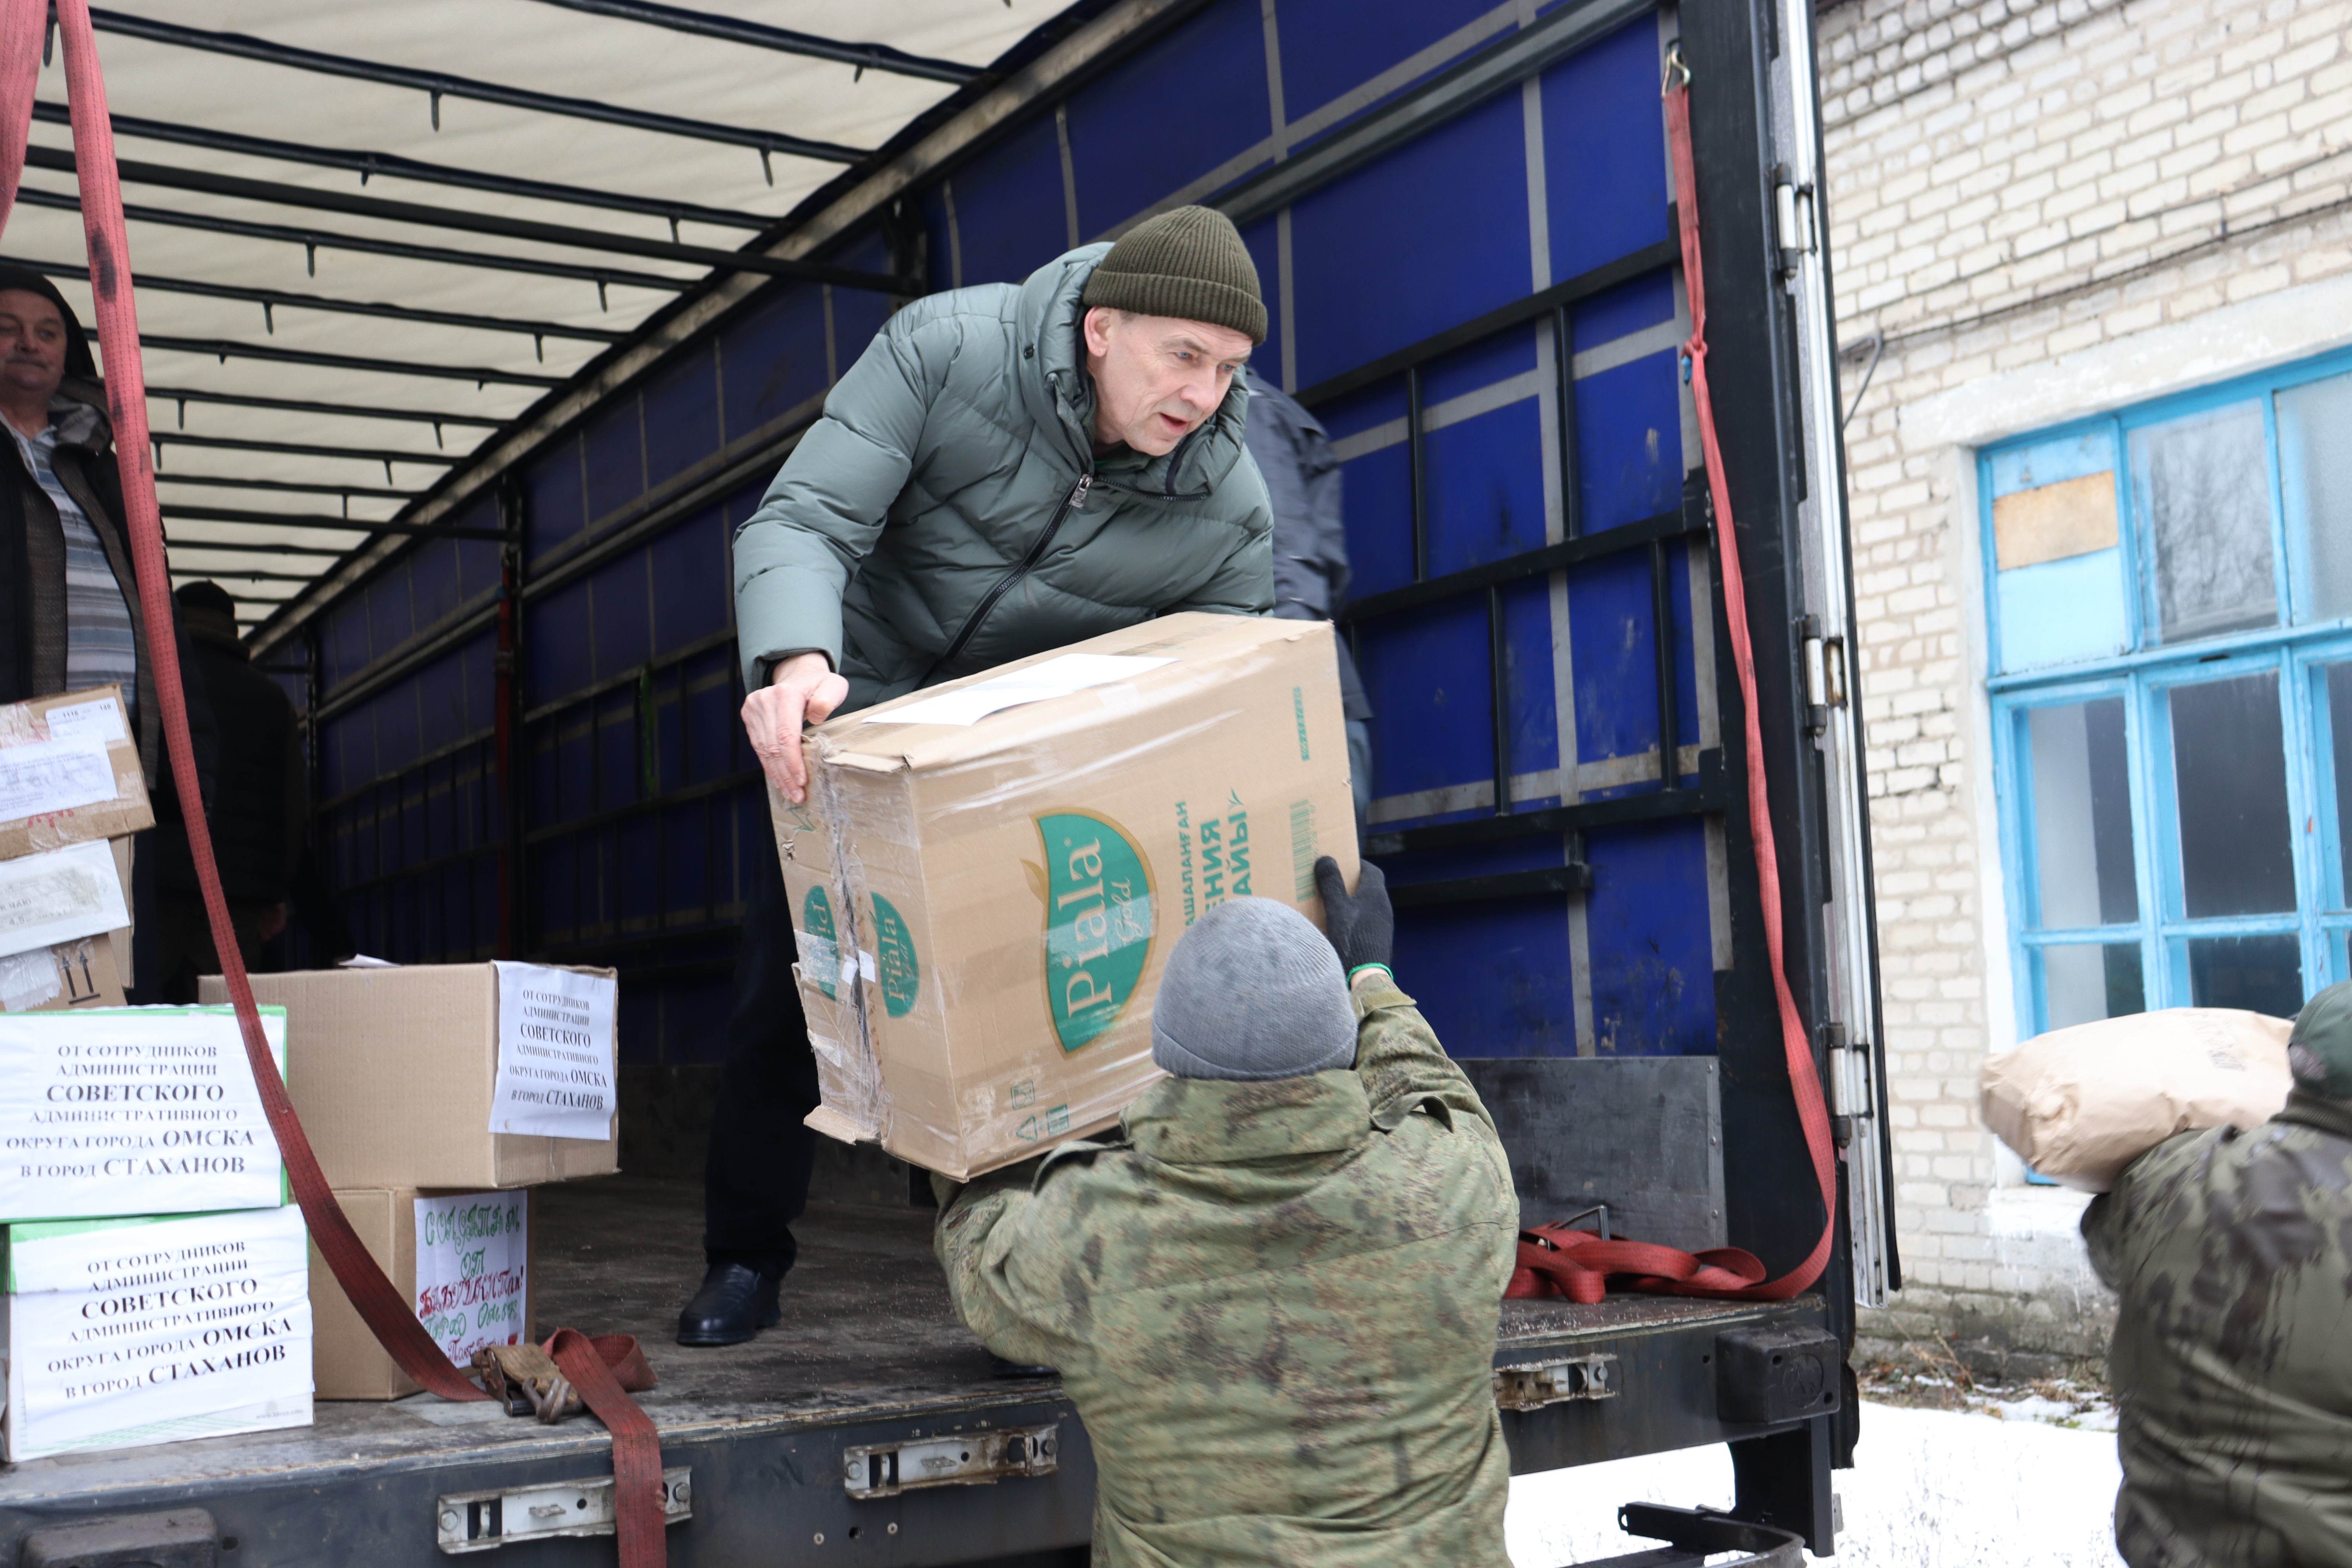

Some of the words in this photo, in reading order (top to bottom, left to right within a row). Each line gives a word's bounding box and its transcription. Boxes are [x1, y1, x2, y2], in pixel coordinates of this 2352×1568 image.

[1226, 811, 1252, 895] АЙЫ
[1111, 876, 1143, 944] Gold
[1057, 837, 1112, 1018] Piala
[523, 990, 535, 1001] ОТ
[536, 992, 590, 1011] СОТРУДНИКОВ
[523, 1006, 590, 1027] АДМИНИСТРАЦИИ
[521, 1024, 591, 1049] СОВЕТСКОГО
[58, 1045, 80, 1058] ОТ
[87, 1045, 217, 1058] СОТРУДНИКОВ
[516, 1045, 598, 1066] АДМИНИСТРАТИВНОГО
[56, 1063, 218, 1078] АДМИНИСТРАЦИИ
[510, 1065, 539, 1080] ОКРУГА
[541, 1069, 569, 1083] ГОРОДА
[571, 1069, 607, 1088] ОМСКА
[47, 1084, 224, 1103] СОВЕТСКОГО
[511, 1089, 516, 1101] В
[518, 1090, 544, 1105] ГОРОД
[547, 1090, 603, 1110] СТАХАНОВ
[30, 1109, 238, 1125] АДМИНИСТРАТИВНОГО
[7, 1136, 79, 1150] ОКРУГА
[85, 1135, 154, 1149] ГОРОДА
[163, 1129, 255, 1147] ОМСКА
[21, 1165, 31, 1178] В
[37, 1164, 96, 1178] ГОРОД
[103, 1156, 245, 1176] СТАХАНОВ
[88, 1260, 111, 1274] ОТ
[116, 1241, 246, 1271] СОТРУДНИКОВ
[89, 1259, 248, 1293] АДМИНИСТРАЦИИ
[82, 1278, 258, 1320] СОВЕТСКОГО
[67, 1300, 274, 1344] АДМИНИСТРАТИВНОГО
[48, 1351, 121, 1373] ОКРУГА
[126, 1338, 196, 1361] ГОРОДА
[203, 1317, 292, 1347] ОМСКА
[65, 1387, 76, 1399] В
[82, 1376, 142, 1398] ГОРОД
[149, 1344, 286, 1385] СТАХАНОВ
